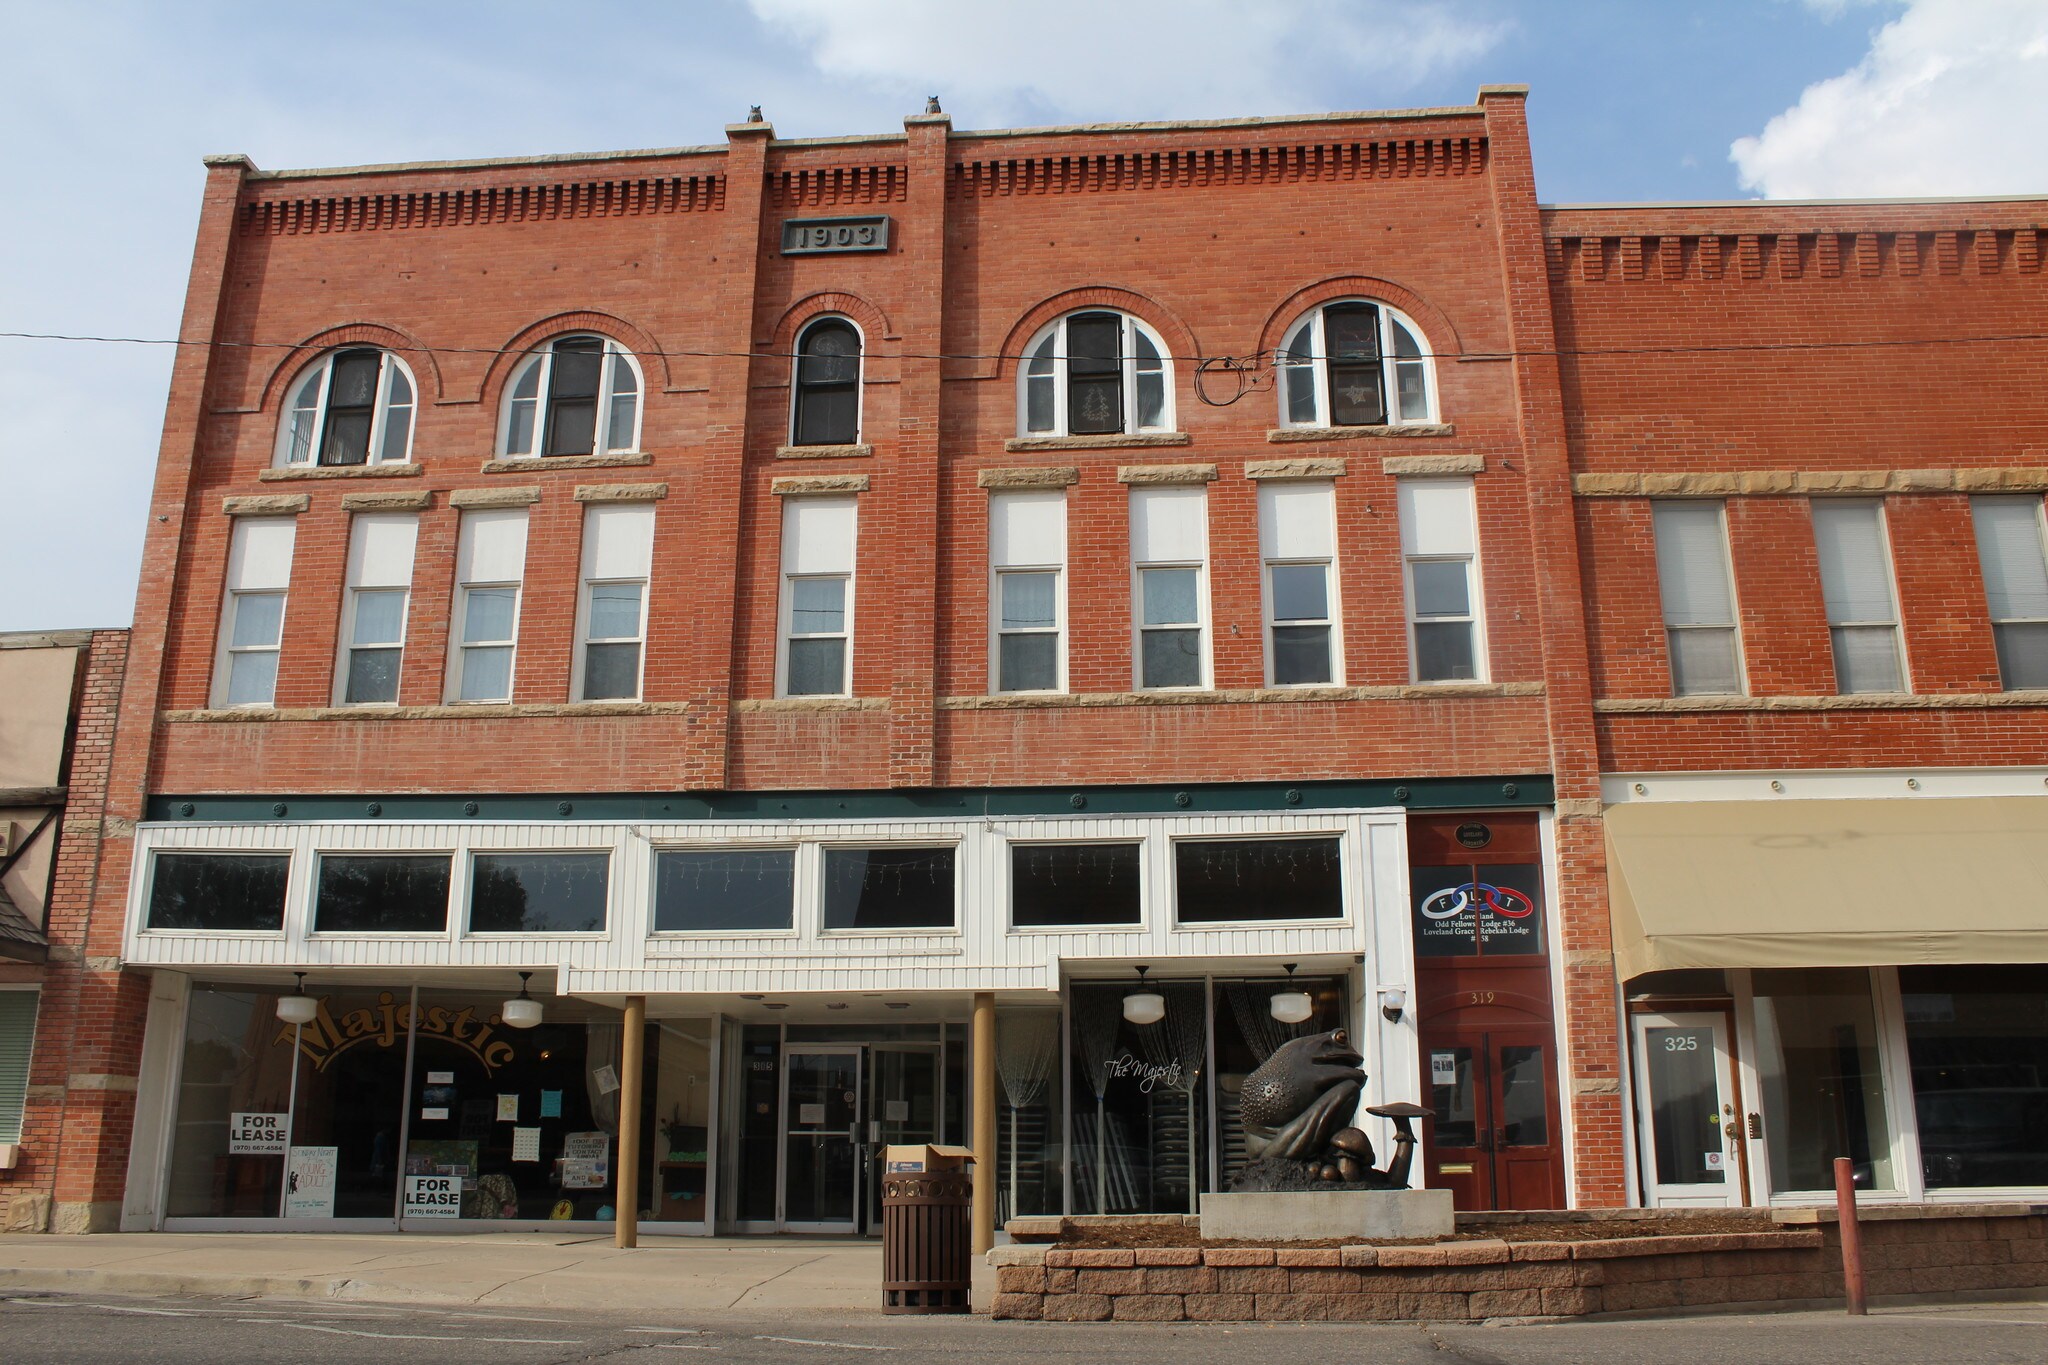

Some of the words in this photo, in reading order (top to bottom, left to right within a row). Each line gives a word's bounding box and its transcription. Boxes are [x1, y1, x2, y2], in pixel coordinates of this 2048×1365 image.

[797, 225, 876, 248] 1903
[1506, 896, 1514, 907] T
[1435, 920, 1449, 928] Odd
[1481, 920, 1501, 929] Lodge
[1423, 928, 1453, 936] Loveland
[1480, 927, 1507, 935] Rebekah
[1509, 927, 1529, 935] Lodge
[1471, 991, 1494, 1004] 319
[272, 991, 514, 1069] Majestic
[1665, 1036, 1698, 1051] 325
[1103, 1053, 1134, 1079] The
[1131, 1057, 1181, 1094] Majestic
[242, 1116, 276, 1128] FOR
[231, 1129, 286, 1141] LEASE
[299, 1174, 328, 1188] ADULT
[416, 1179, 450, 1191] FOR
[405, 1192, 459, 1205] LEASE
